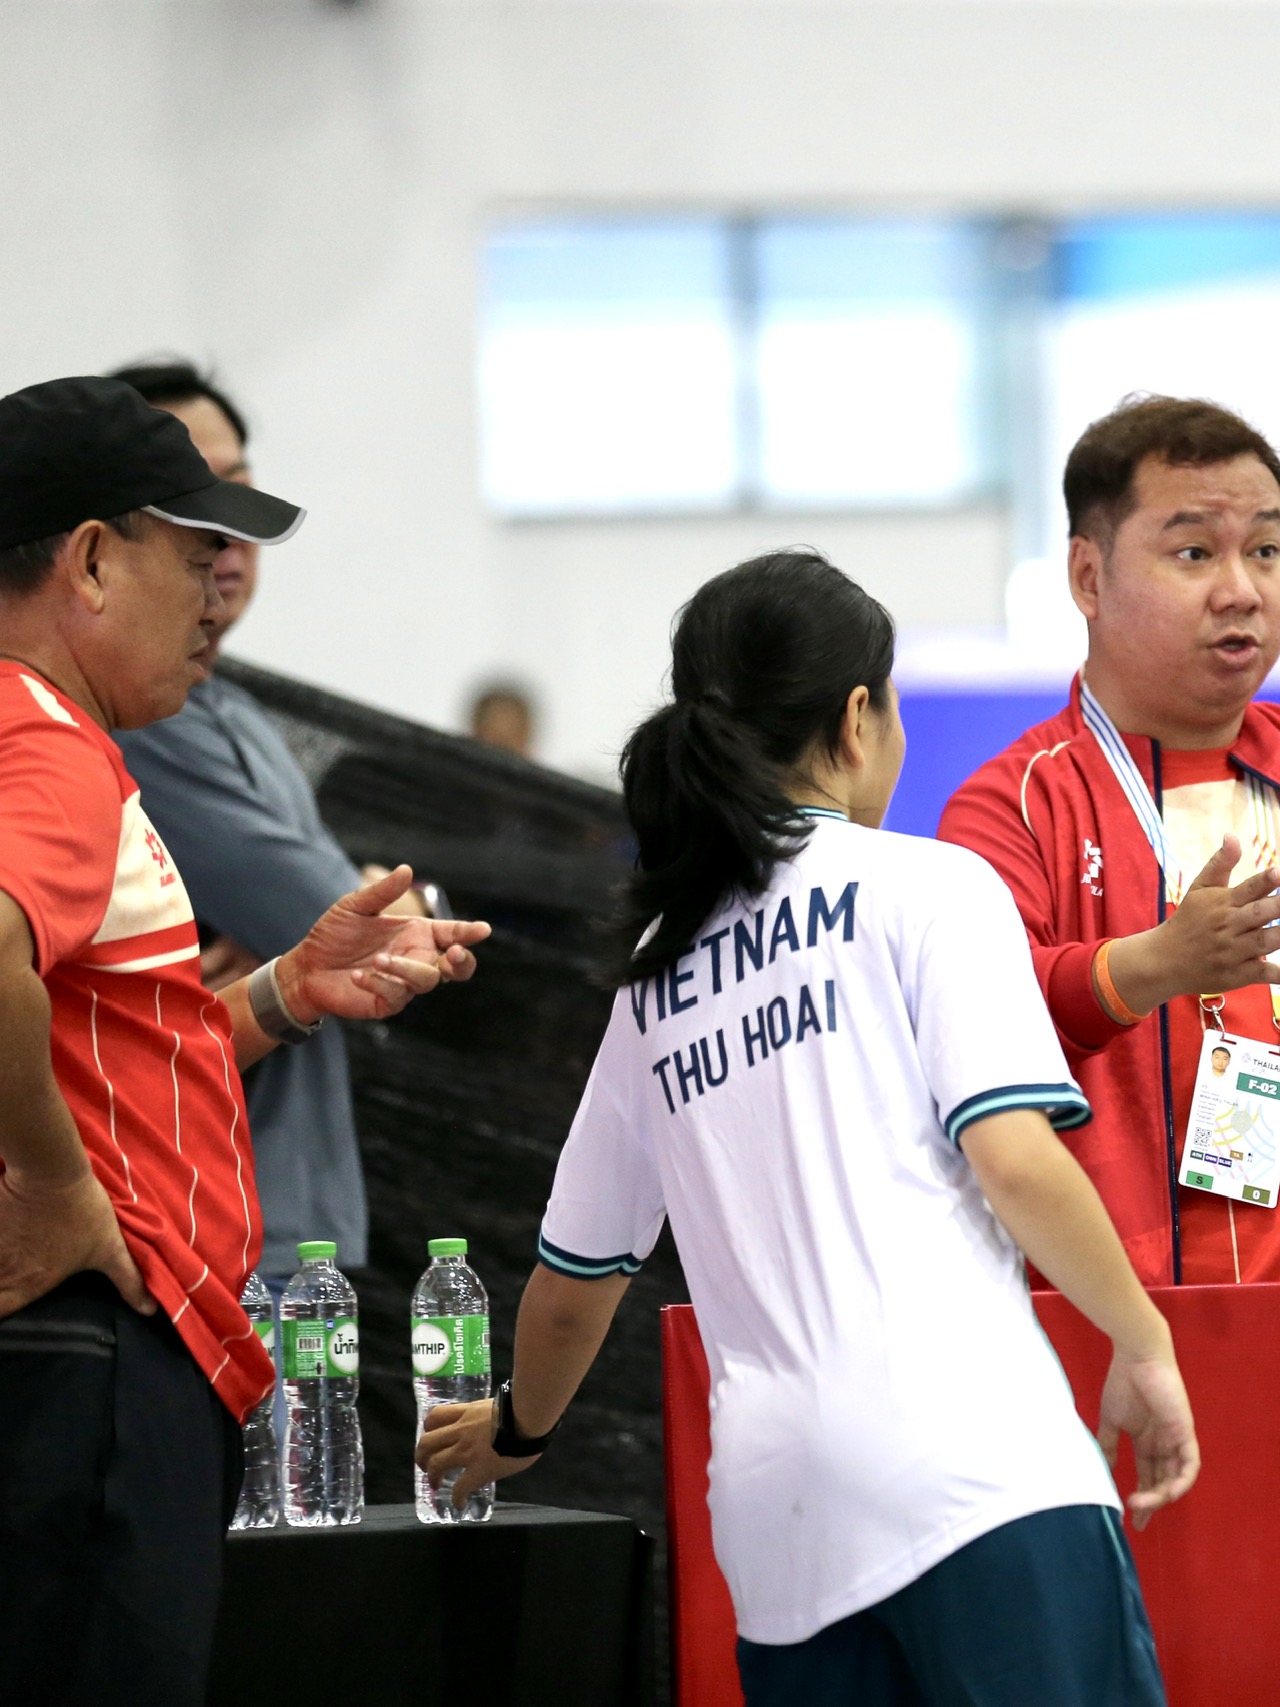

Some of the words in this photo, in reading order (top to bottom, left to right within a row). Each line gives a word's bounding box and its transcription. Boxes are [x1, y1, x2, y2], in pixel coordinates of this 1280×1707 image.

[630, 881, 860, 1036] VIETNAM
[652, 1028, 729, 1115] THU
[742, 979, 838, 1068] HOAI
[1248, 1079, 1277, 1096] F-02
[1195, 1175, 1204, 1185] S
